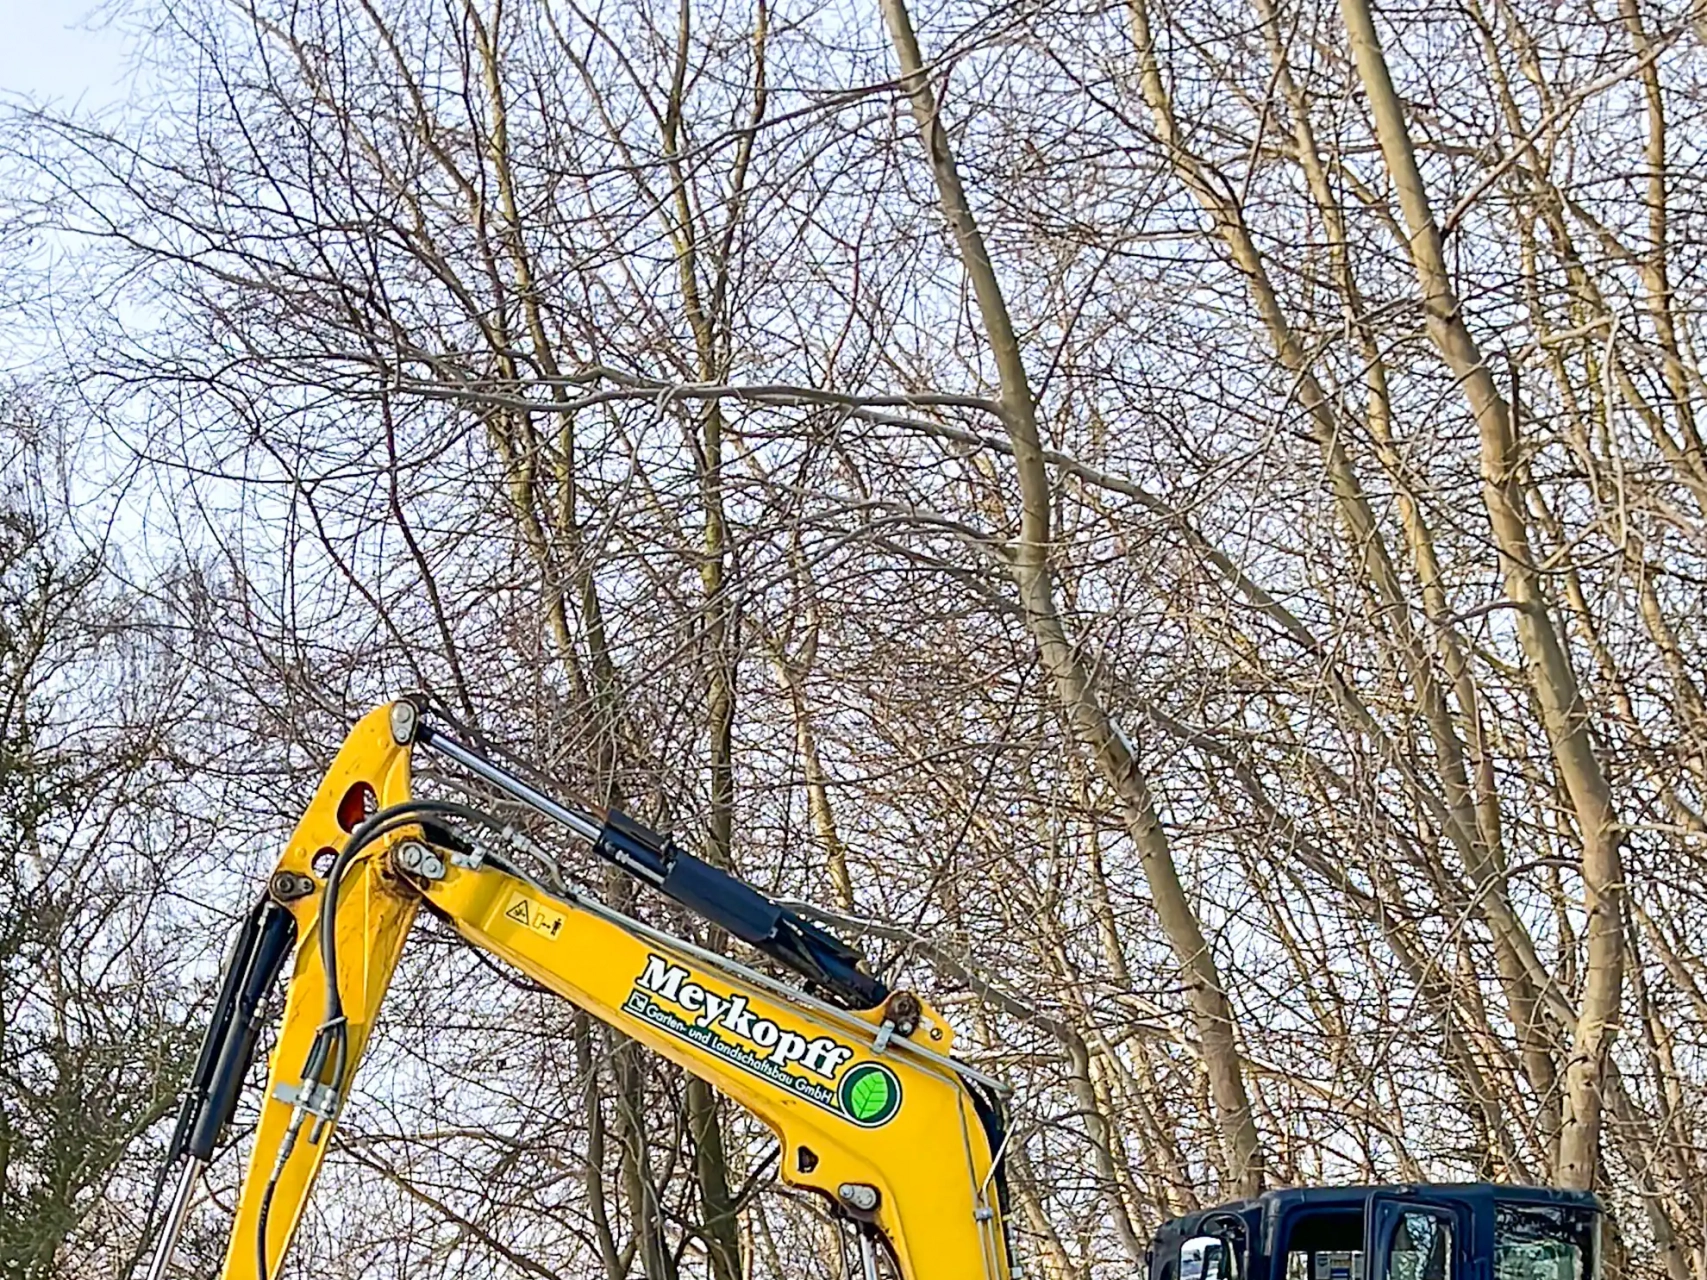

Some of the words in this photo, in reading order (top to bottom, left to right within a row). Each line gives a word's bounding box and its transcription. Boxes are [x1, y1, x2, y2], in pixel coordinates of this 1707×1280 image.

[635, 955, 852, 1079] Meykopff
[645, 1004, 687, 1032] Garten-
[688, 1028, 712, 1044] und
[711, 1036, 793, 1085] Landschaftsbau
[794, 1075, 832, 1102] GmbH
